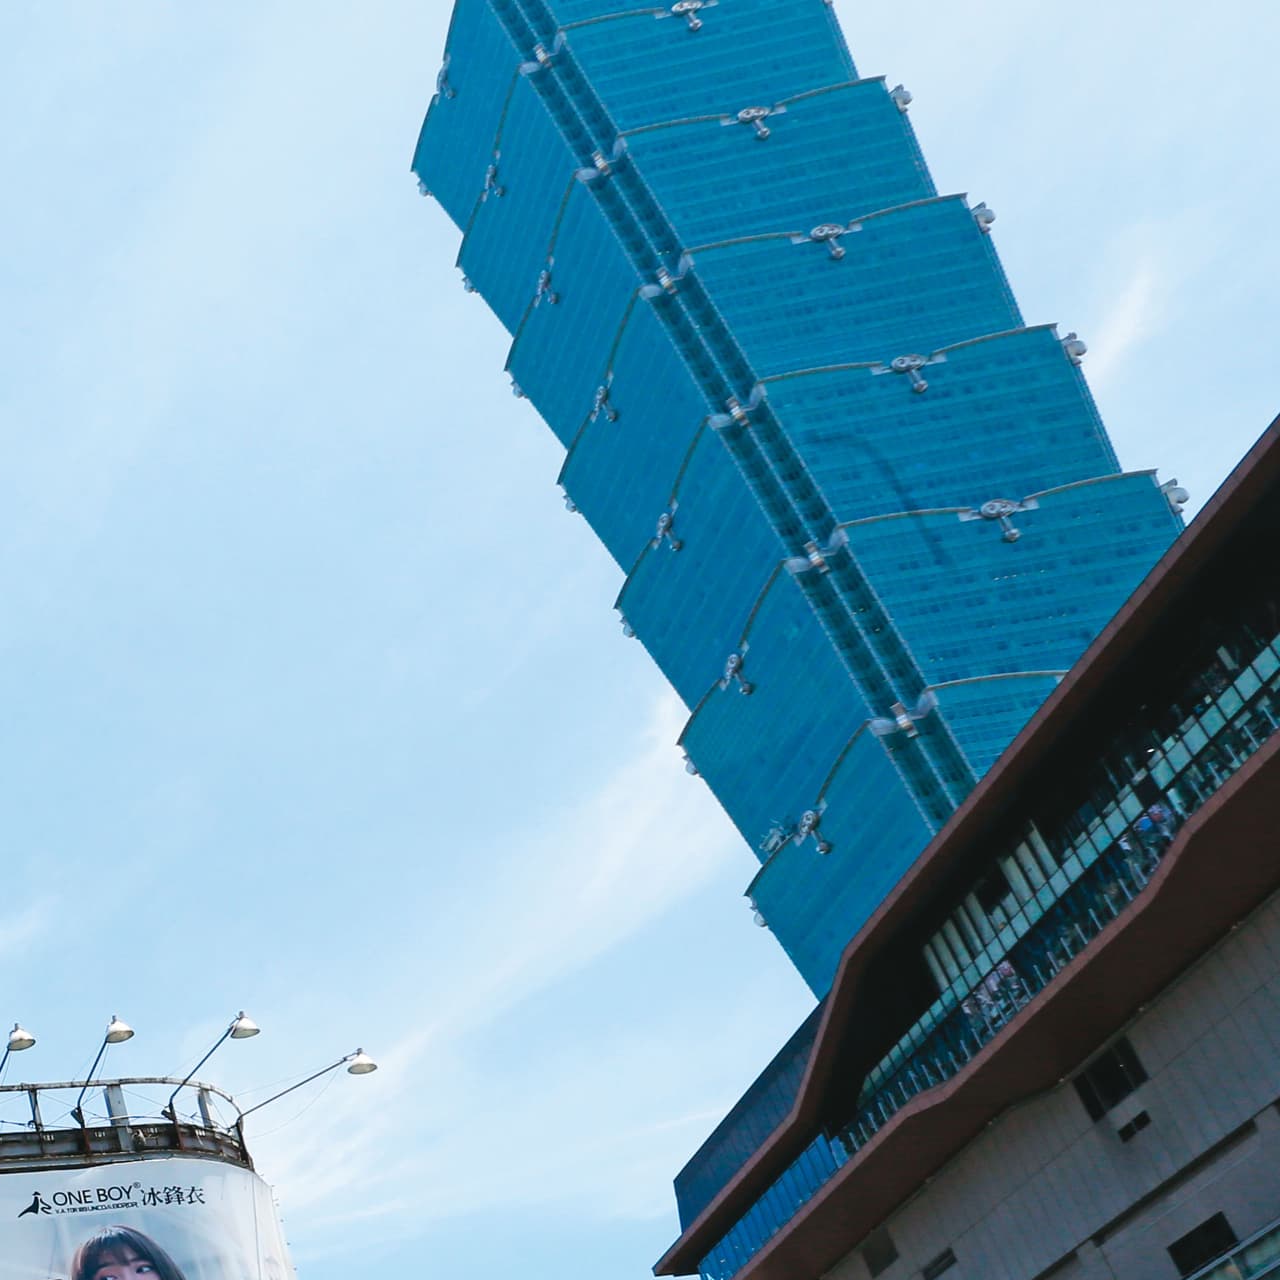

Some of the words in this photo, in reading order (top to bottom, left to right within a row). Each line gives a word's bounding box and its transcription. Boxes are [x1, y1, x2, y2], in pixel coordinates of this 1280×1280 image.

[52, 1189, 91, 1206] ONE
[141, 1186, 206, 1207] 冰鋒衣
